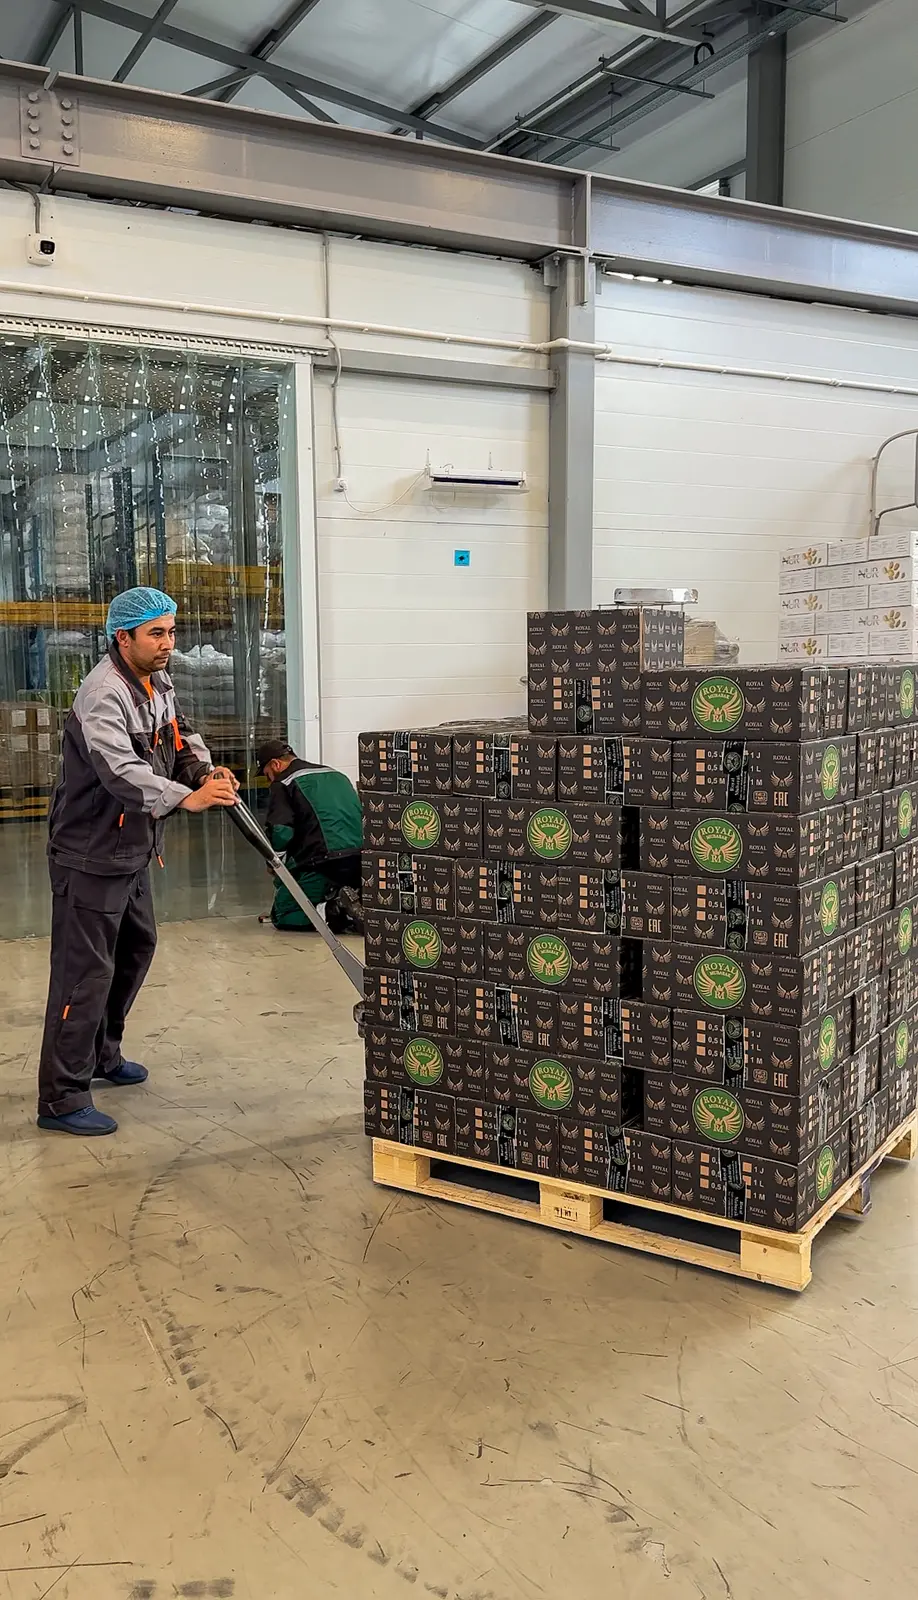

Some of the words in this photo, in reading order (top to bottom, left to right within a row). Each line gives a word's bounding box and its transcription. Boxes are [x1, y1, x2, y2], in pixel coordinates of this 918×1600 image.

[703, 685, 736, 695] ROYAL
[774, 792, 788, 806] EAC
[409, 808, 433, 816] ROYAL
[536, 816, 564, 825] ROYAL
[701, 826, 732, 836] ROYAL
[648, 919, 662, 933] EAC
[410, 927, 434, 936] ROYAL
[774, 933, 788, 948] EAC
[535, 941, 564, 952] ROYAL
[704, 962, 736, 974] ROYAL
[538, 1032, 550, 1047] EAC
[411, 1045, 437, 1055] ROYAL
[538, 1067, 566, 1079] ROYAL
[774, 1072, 789, 1088] EAC
[703, 1096, 736, 1108] ROYAL
[709, 1103, 730, 1111] MUBARAK
[772, 1122, 790, 1130] ROYAL
[537, 1155, 549, 1169] EAC
[700, 1194, 716, 1202] ROYAL
[750, 1206, 767, 1214] ROYAL
